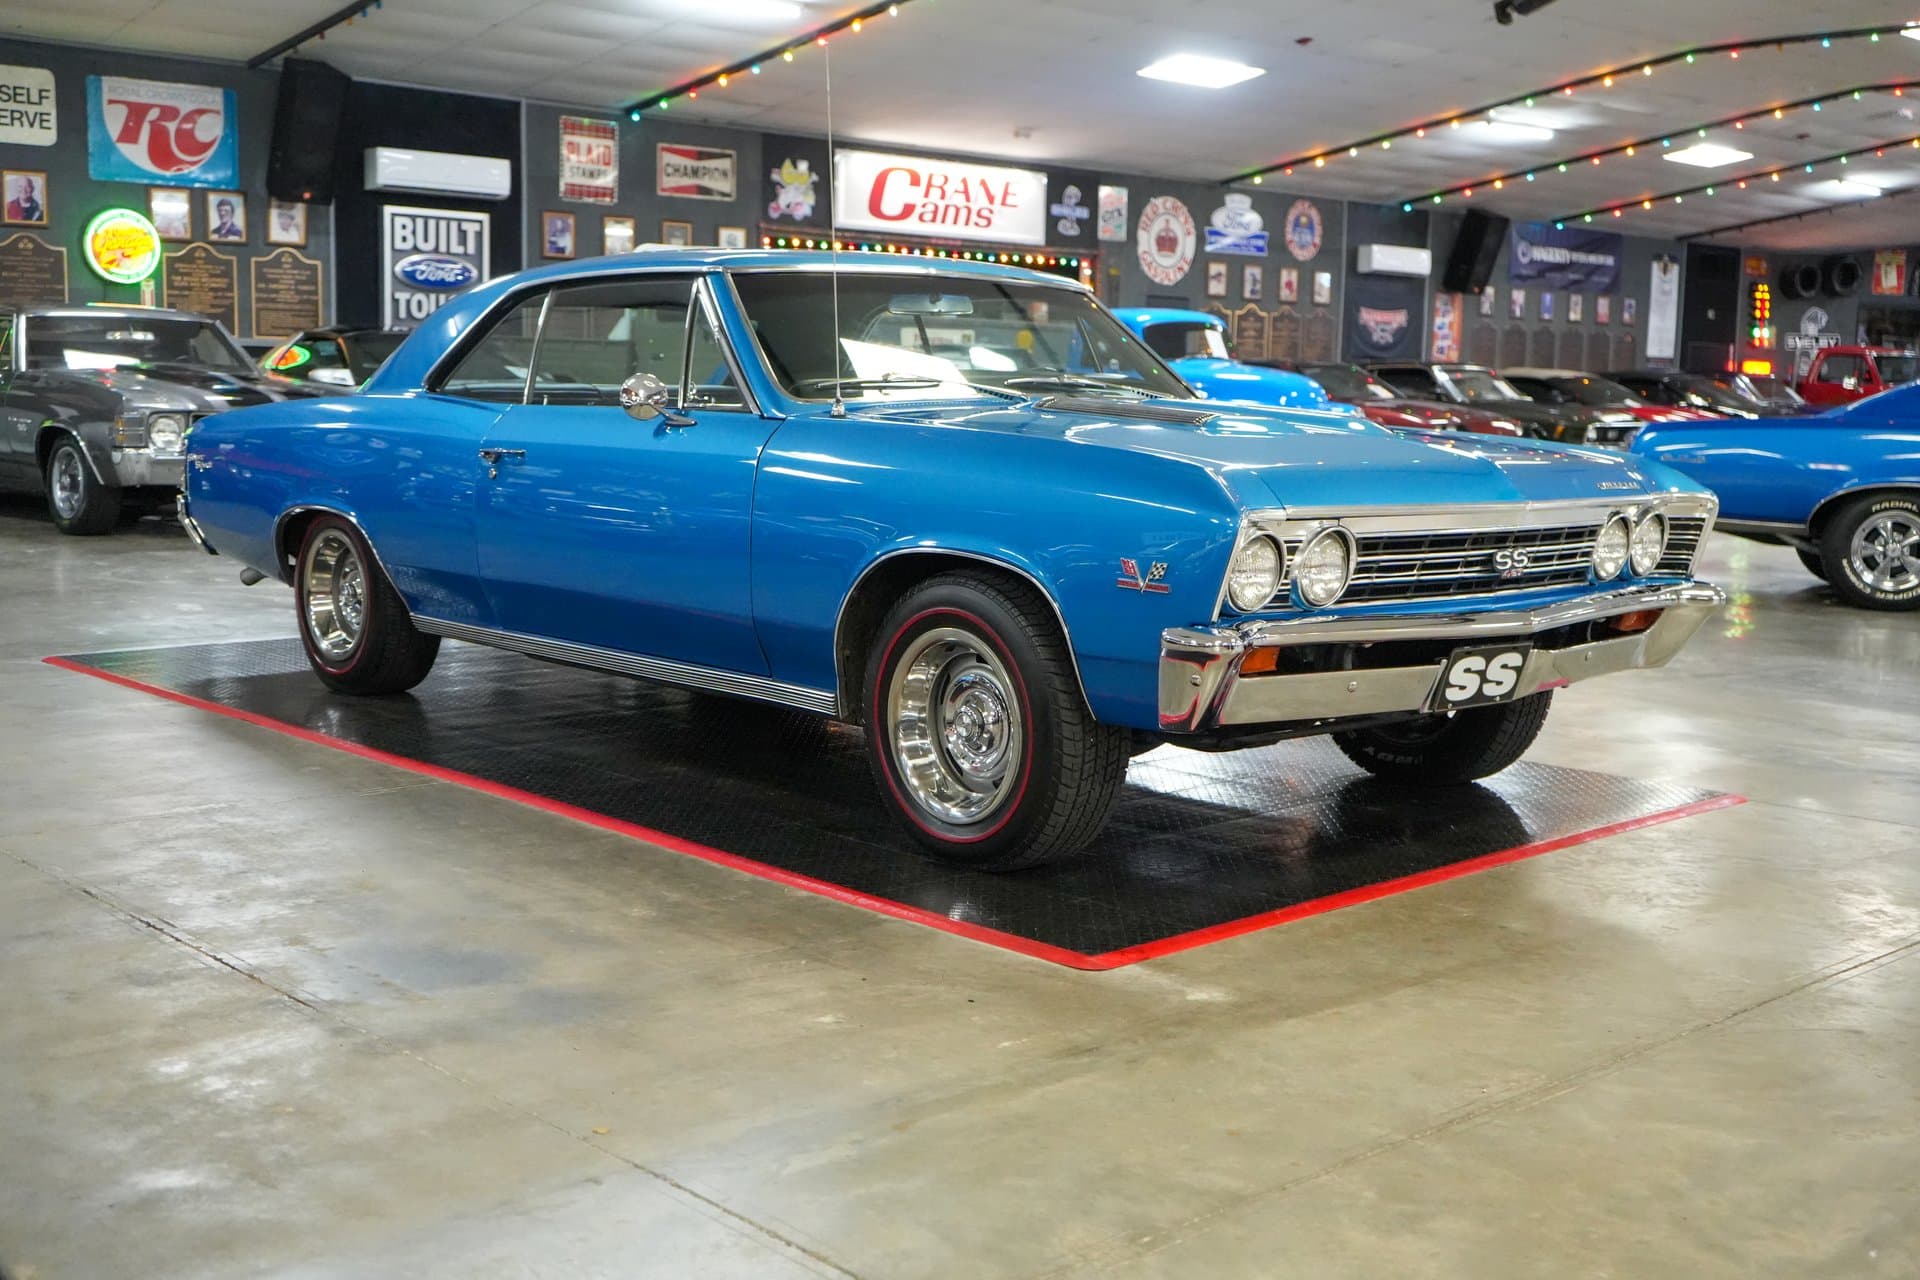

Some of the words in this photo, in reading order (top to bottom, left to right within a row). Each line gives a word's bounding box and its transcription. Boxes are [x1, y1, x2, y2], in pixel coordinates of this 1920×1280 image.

[0, 84, 51, 106] SELF
[106, 98, 221, 172] RC
[664, 163, 730, 182] CHAMPION
[393, 215, 481, 255] BUILT
[403, 261, 463, 282] Ford
[394, 292, 457, 319] TOU
[1872, 500, 1919, 513] RADIAL
[1495, 549, 1529, 570] SS
[1445, 652, 1523, 701] SS
